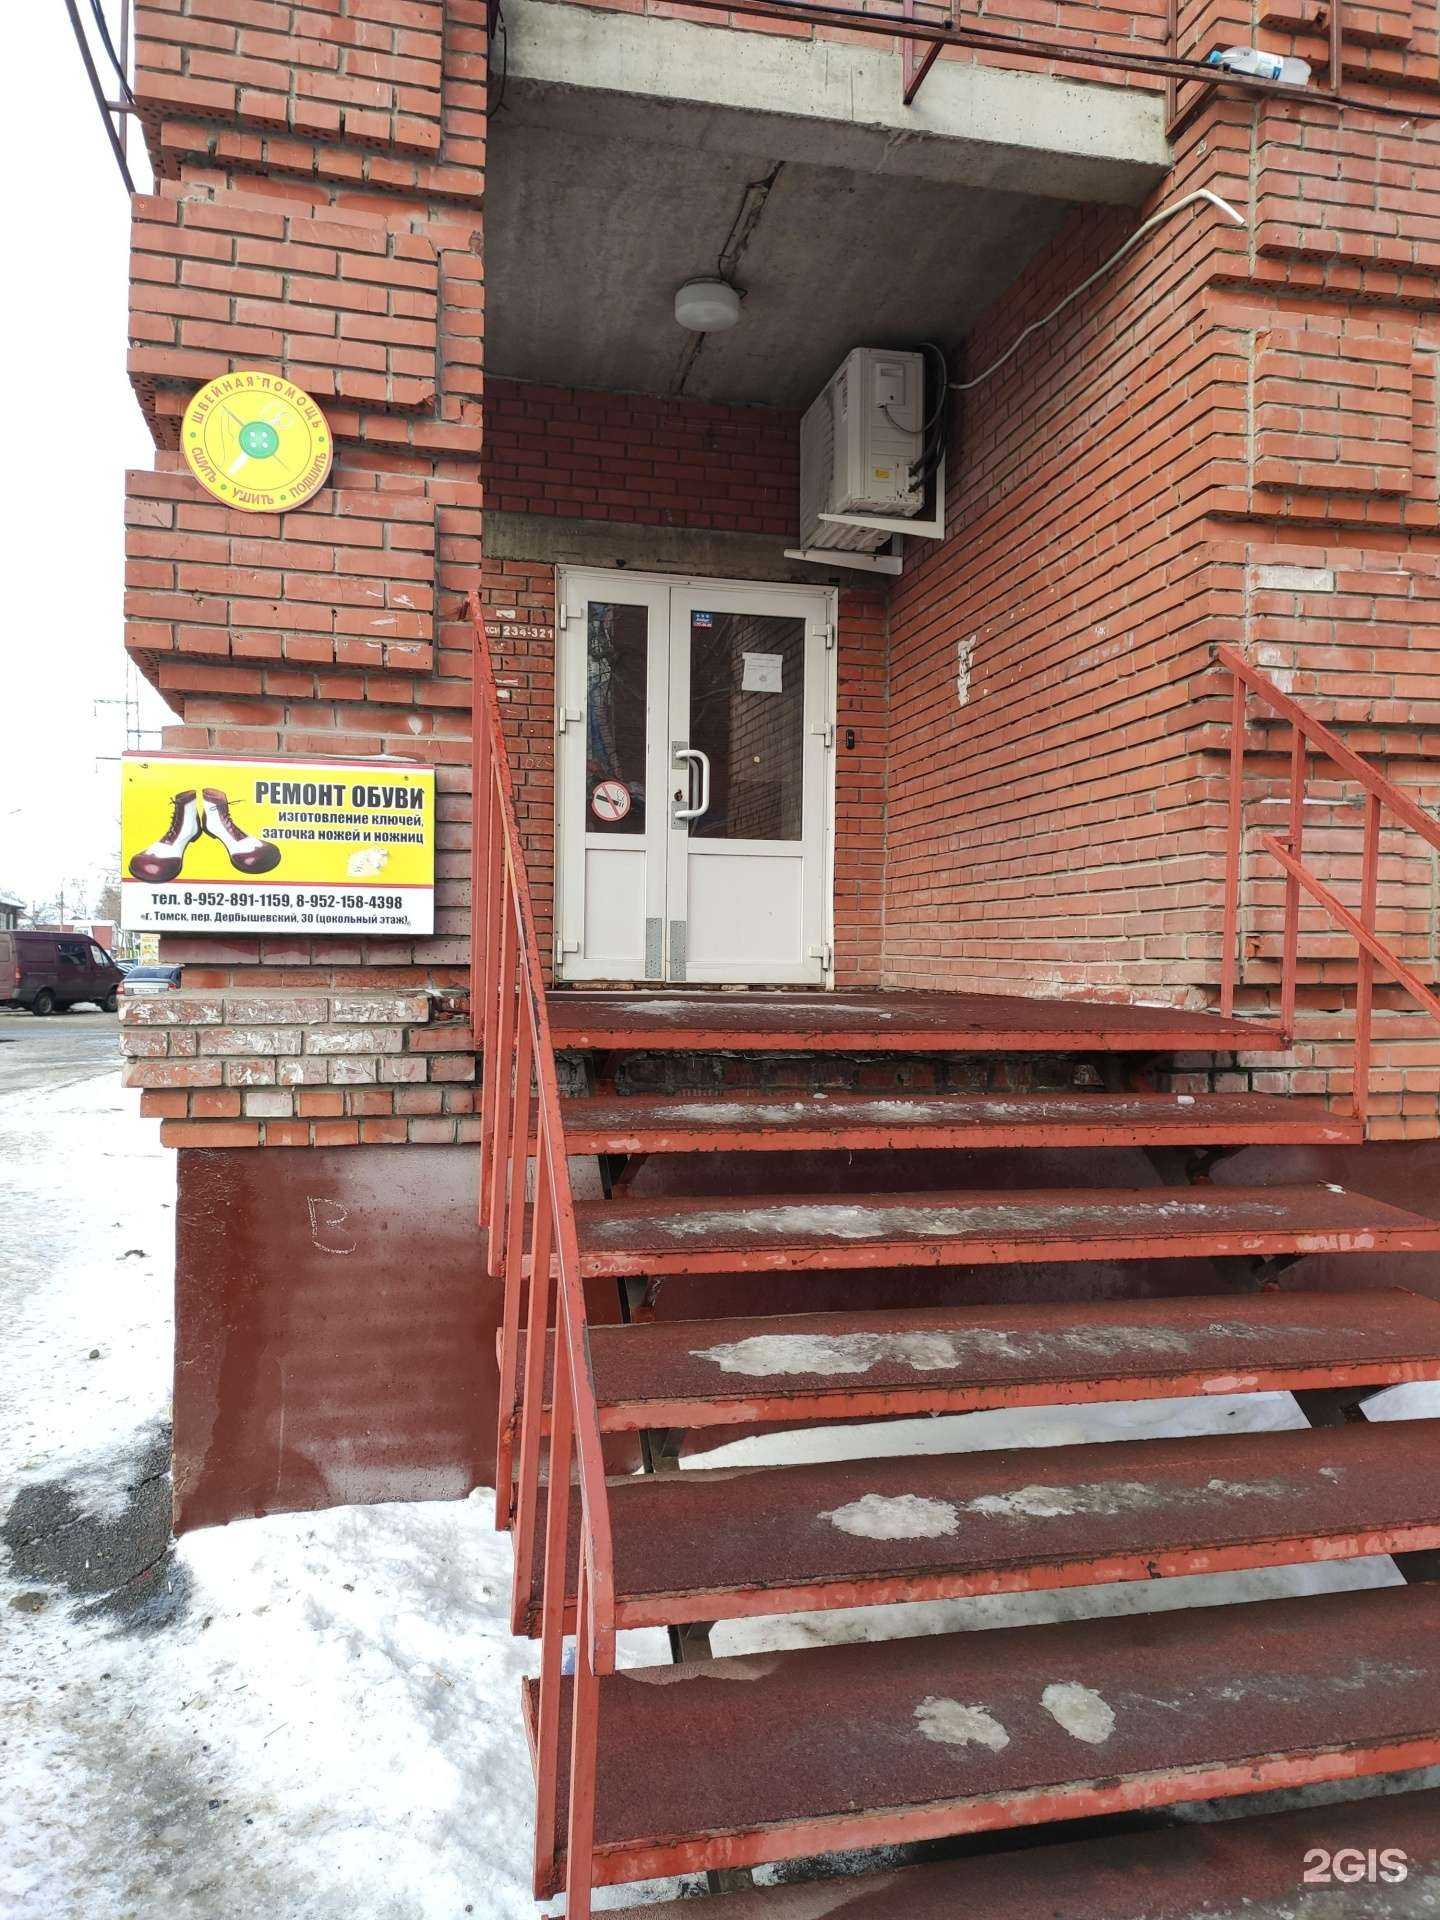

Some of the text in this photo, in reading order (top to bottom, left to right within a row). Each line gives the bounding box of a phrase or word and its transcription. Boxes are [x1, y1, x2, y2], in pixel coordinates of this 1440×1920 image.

[191, 376, 321, 429] ШВЕЙНАЯ ПОМОЩЬ
[191, 447, 217, 484] СШИТЬ
[289, 452, 327, 498] ПОДШИТЬ
[233, 487, 275, 505] УШИТЬ
[503, 625, 553, 639] 234-321
[255, 781, 424, 810] РЕМОНТ ОБУВИ
[278, 811, 424, 828] изготовление ключей,
[262, 828, 424, 845] заточка ножей и ножниц
[151, 892, 403, 910] тел. 8-952-891-1159, 8-952-158-4398
[154, 911, 189, 922] Томск,
[191, 913, 213, 923] пер.
[213, 912, 299, 924] Дербышевский,
[301, 913, 314, 924] 30
[315, 914, 378, 925] (цокольный
